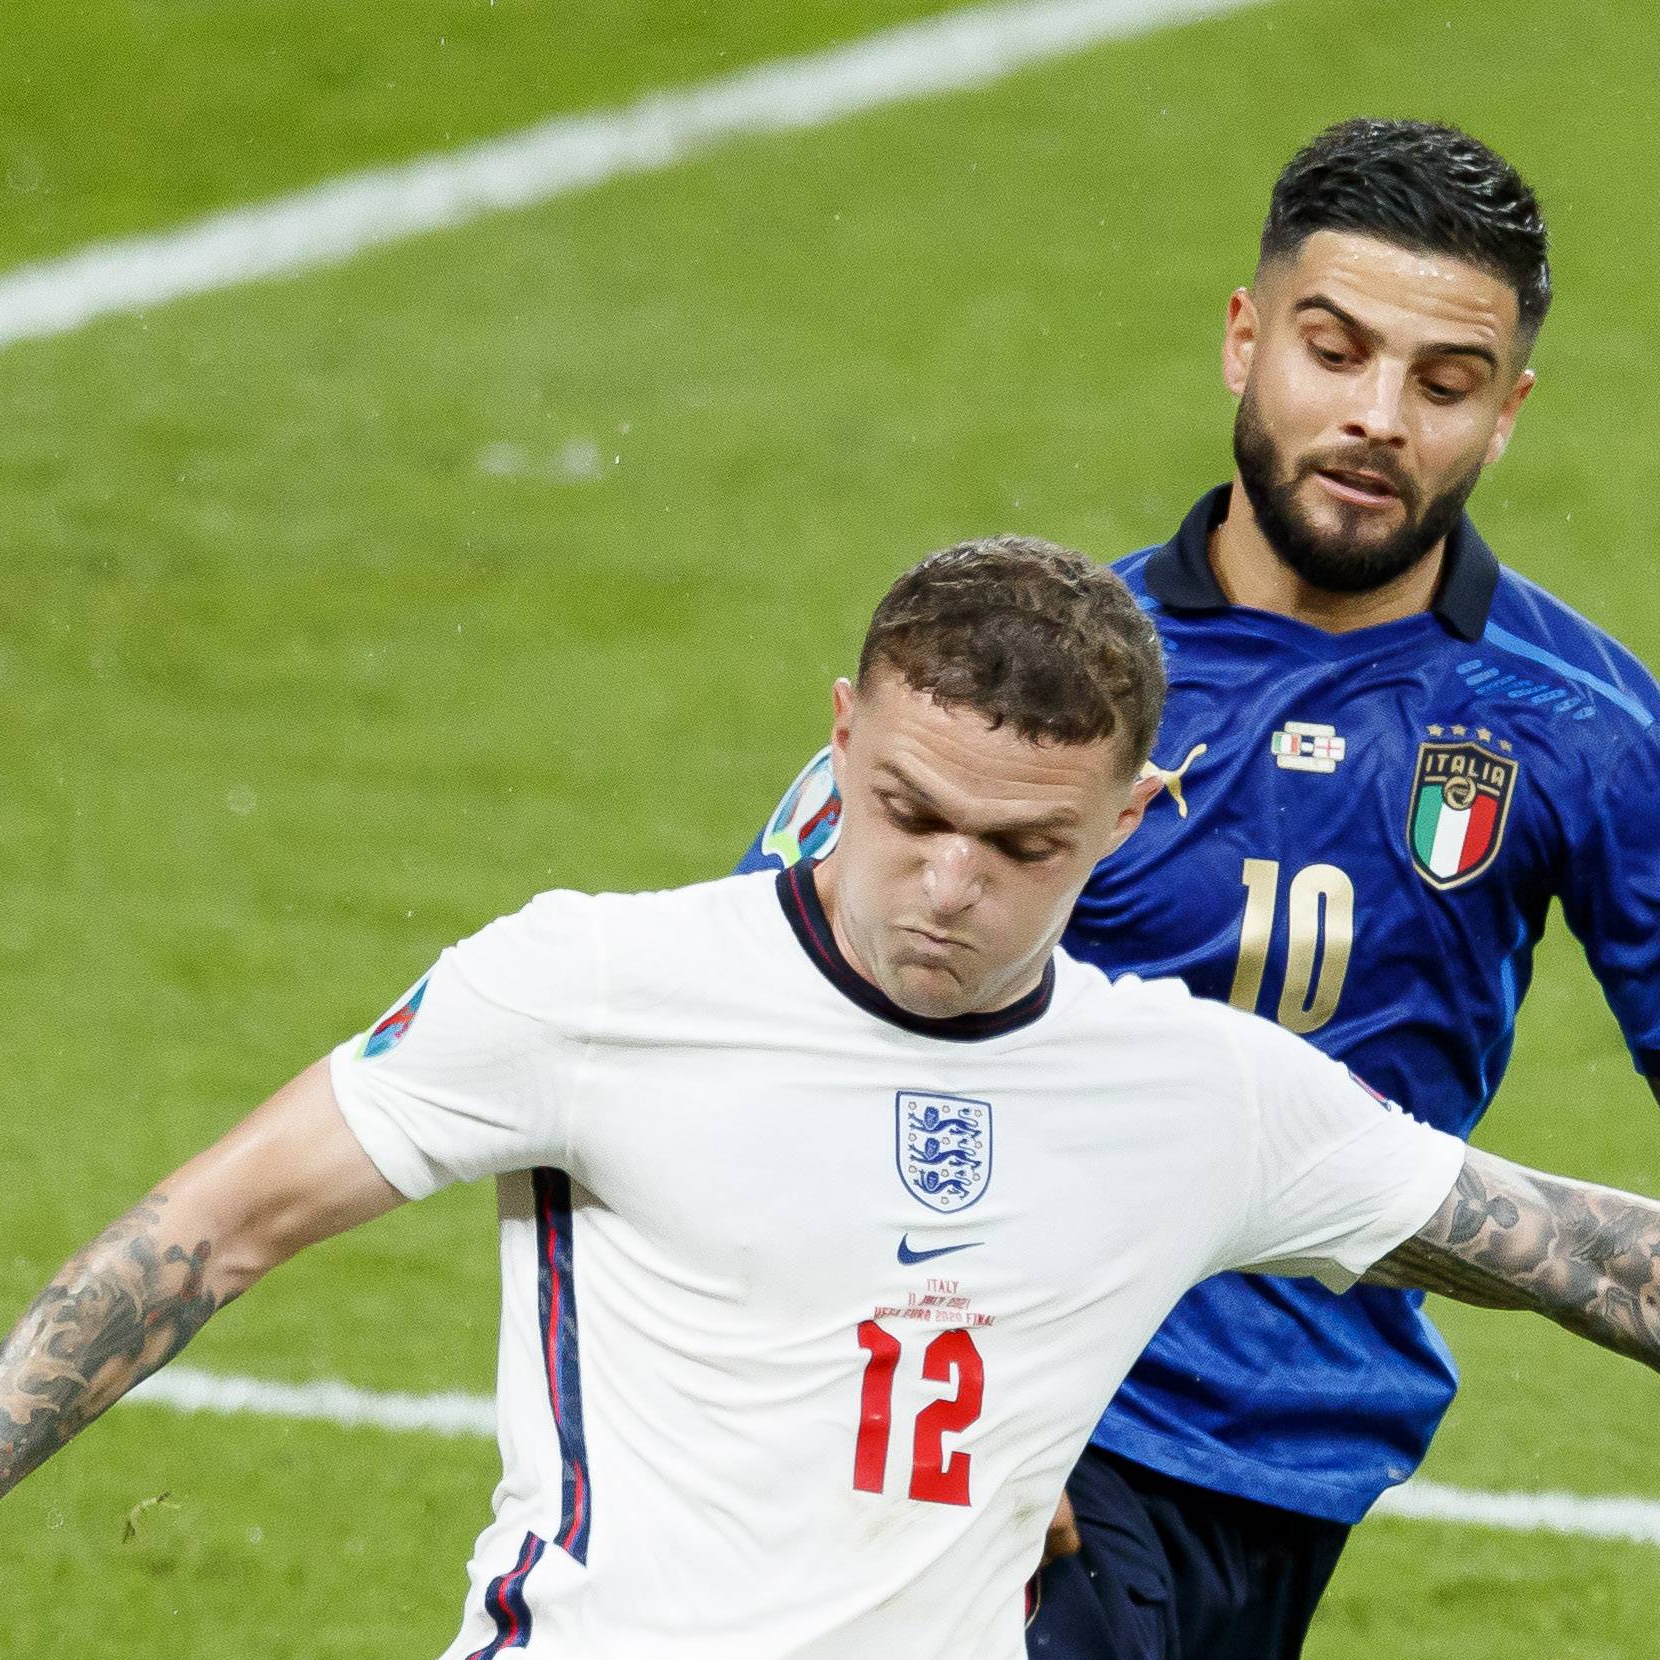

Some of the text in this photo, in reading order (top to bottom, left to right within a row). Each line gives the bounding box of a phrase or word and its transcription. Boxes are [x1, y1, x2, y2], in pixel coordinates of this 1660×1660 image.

[1425, 753, 1506, 788] ITALIA
[1228, 857, 1355, 1034] 10
[926, 1278, 959, 1294] ITALY
[935, 1309, 963, 1323] 2020
[853, 1319, 985, 1507] 12
